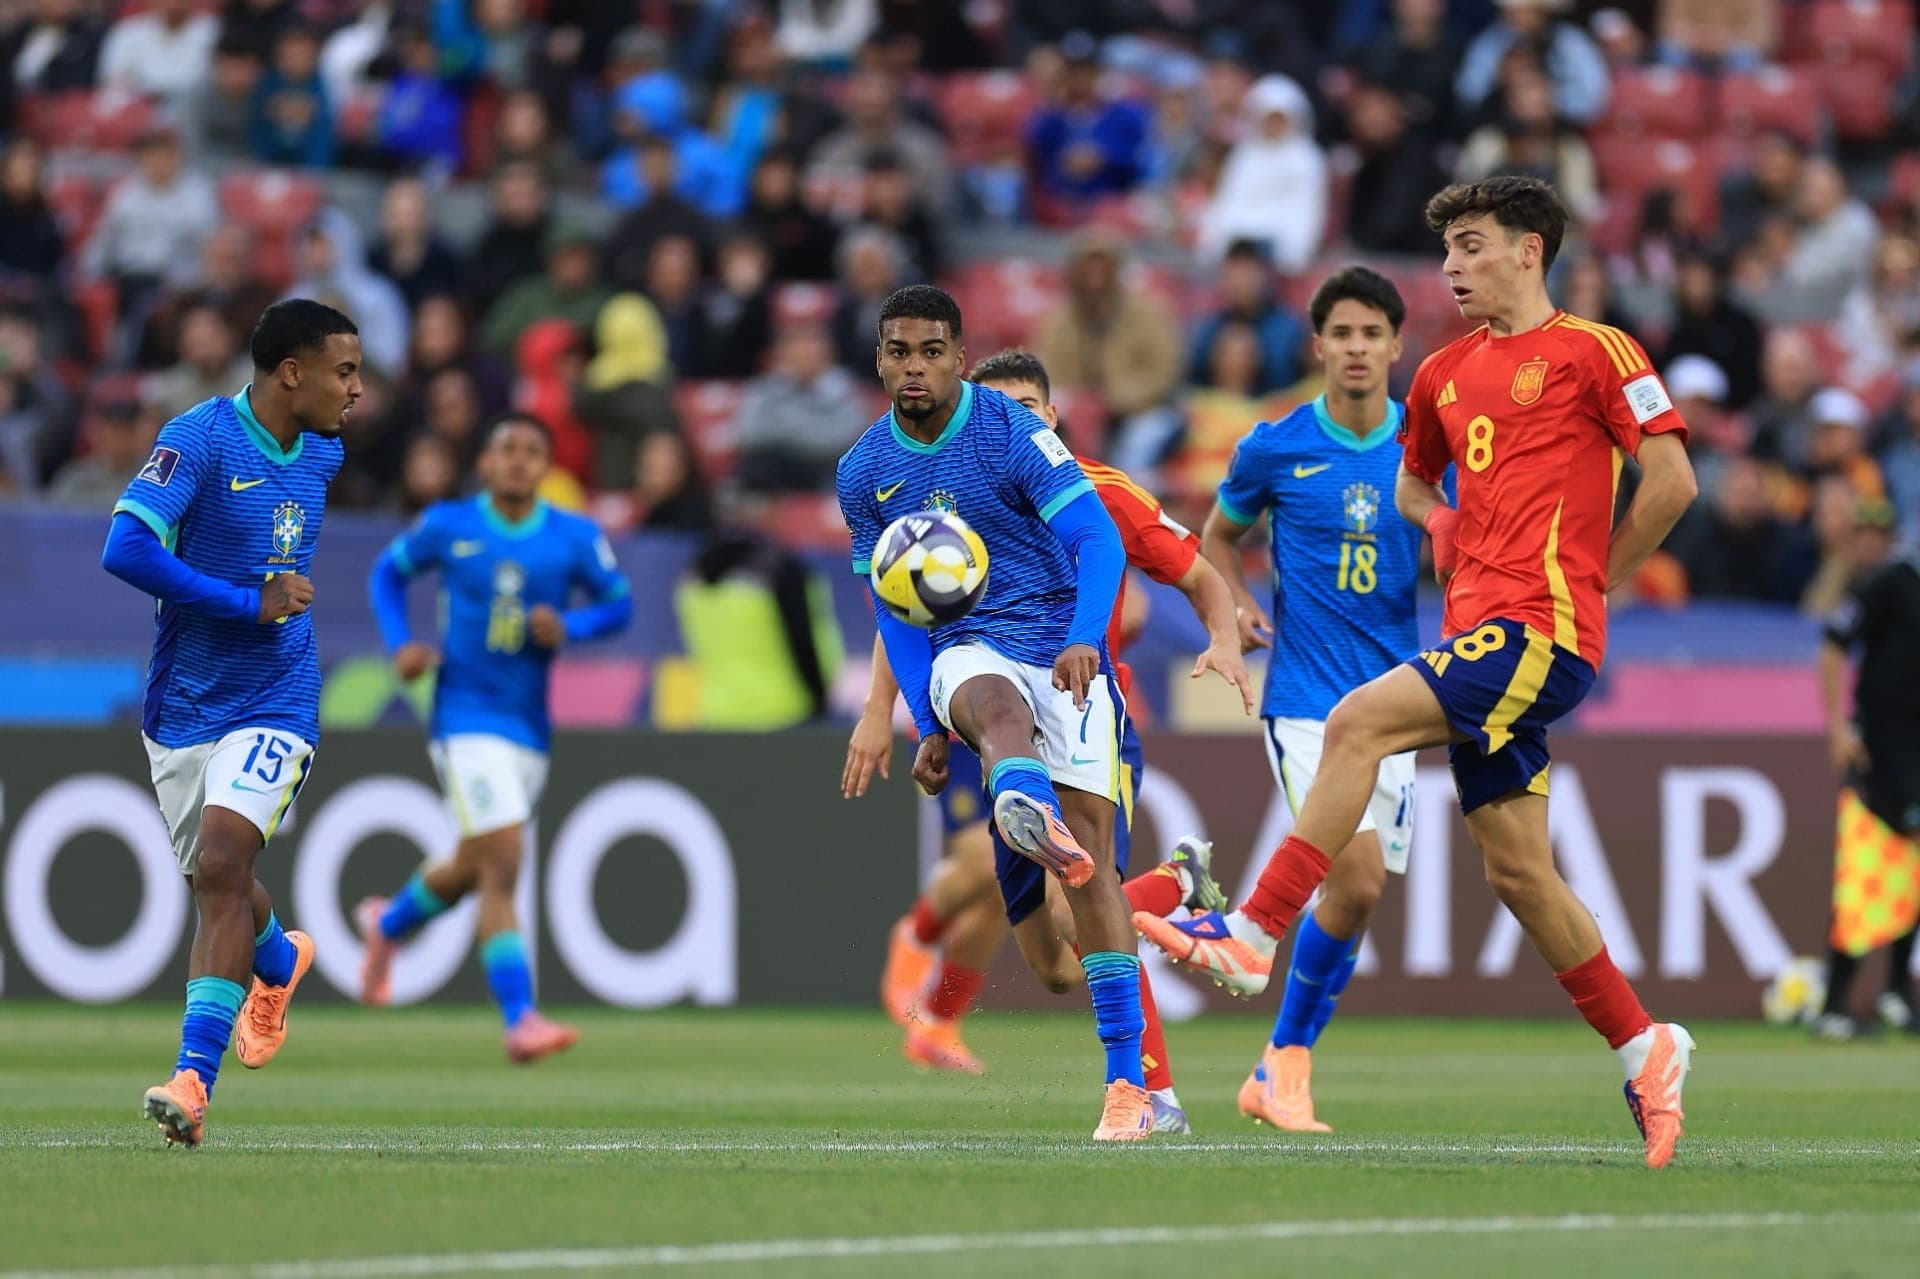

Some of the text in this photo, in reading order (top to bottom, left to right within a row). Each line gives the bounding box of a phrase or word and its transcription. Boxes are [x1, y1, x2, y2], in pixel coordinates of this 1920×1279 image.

[1466, 415, 1495, 473] 8
[1337, 542, 1377, 594] 18
[1453, 624, 1506, 662] 8
[1071, 697, 1093, 744] 7
[242, 733, 293, 784] 15
